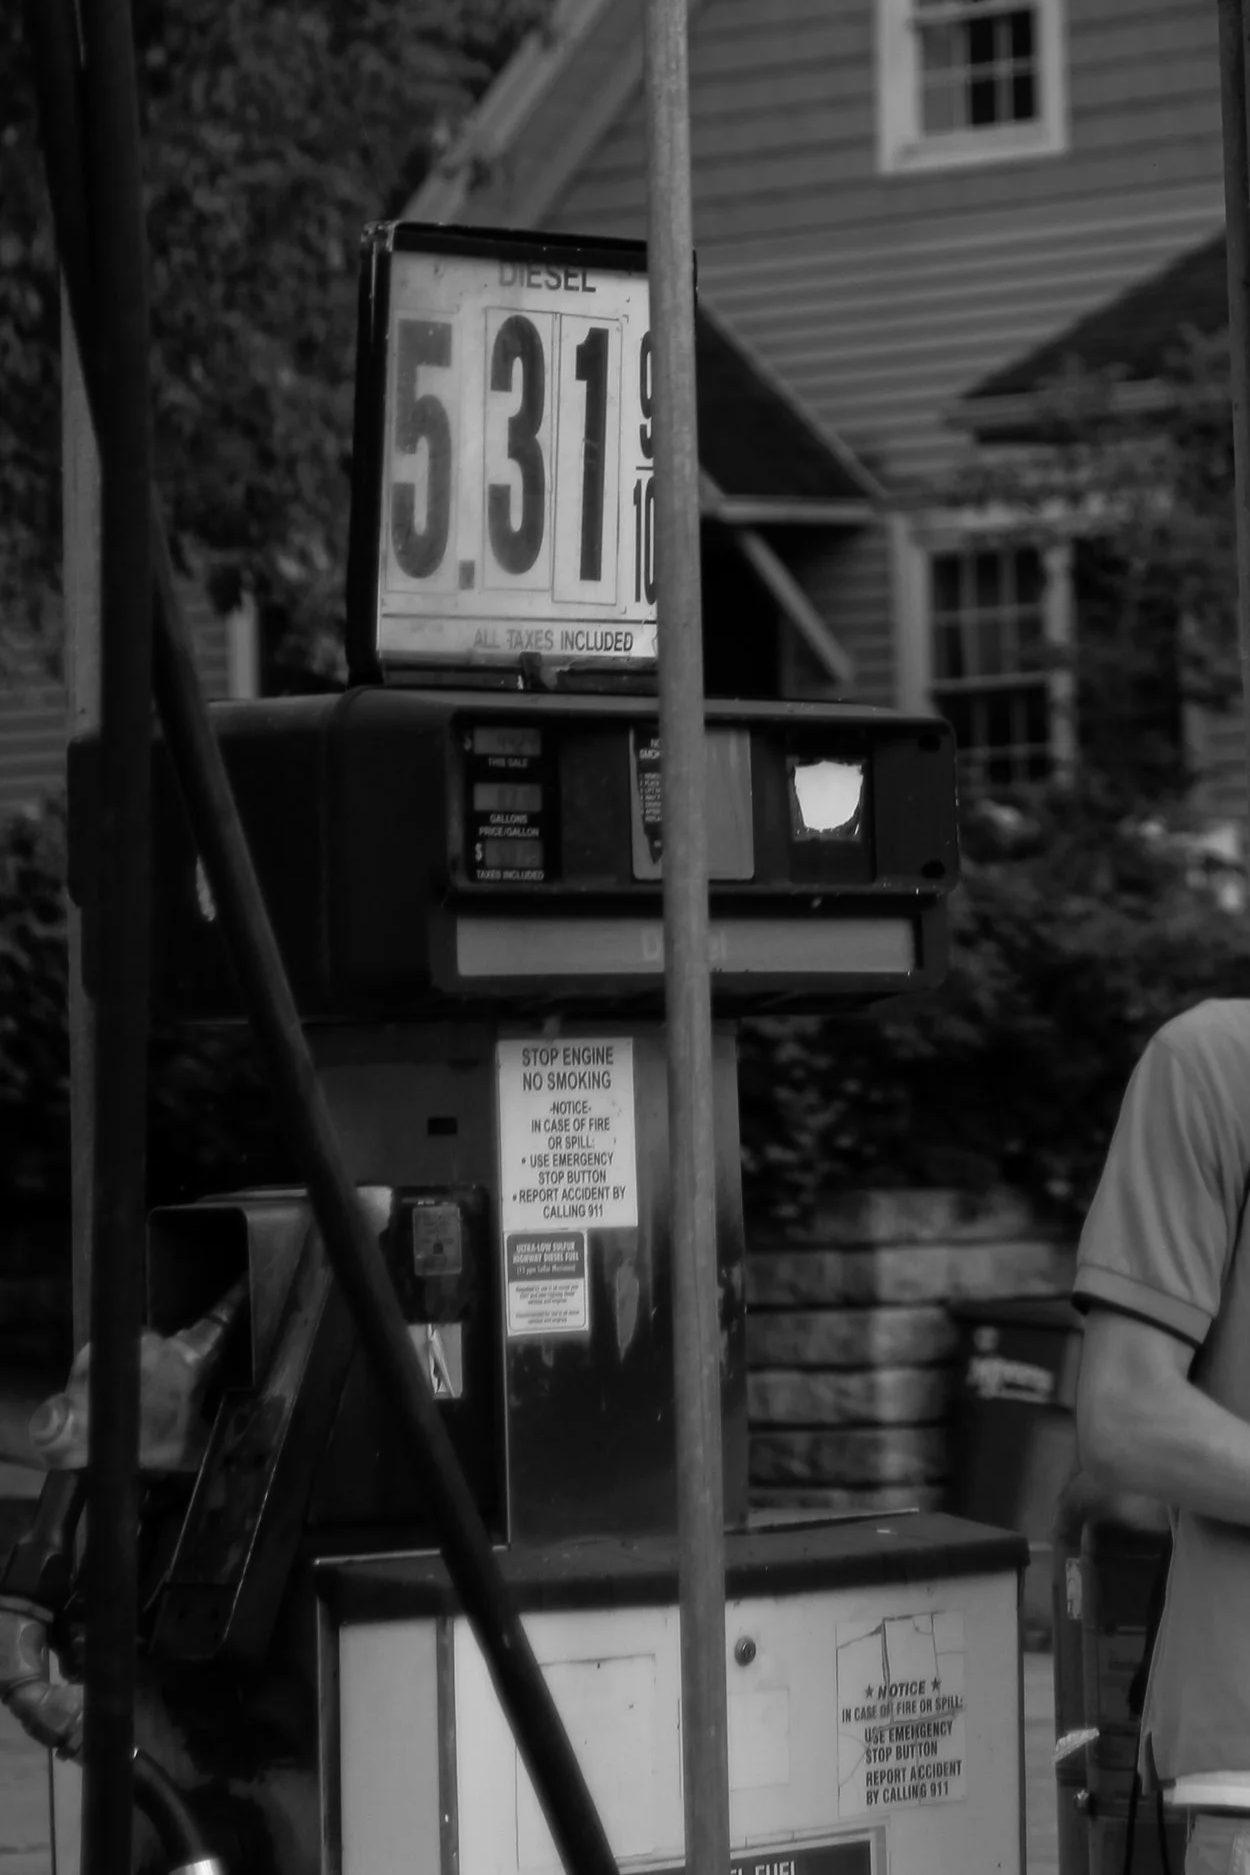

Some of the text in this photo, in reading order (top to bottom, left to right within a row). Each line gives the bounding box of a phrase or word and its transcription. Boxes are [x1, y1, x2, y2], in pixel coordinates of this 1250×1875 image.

[500, 263, 596, 293] DIESEL
[474, 628, 633, 652] ALL TAXES INCLUDED
[508, 758, 528, 768] SALE
[489, 814, 528, 824] GALLONS
[479, 827, 539, 838] PRICE/GALLON
[476, 869, 544, 880] TAXES INCLUDED
[522, 1046, 613, 1066] STOP ENGINE
[523, 1071, 611, 1091] NO SMOKING
[532, 1117, 610, 1133] IN CASE OF FIRE
[548, 1136, 562, 1149] OR
[530, 1152, 613, 1168] USE EMERGENCY
[539, 1170, 606, 1185] STOP BUTTON
[519, 1186, 626, 1203] REPORT ACCIDENT BY
[543, 1204, 603, 1219] CALLING 911
[878, 1680, 926, 1700] NOTICE
[842, 1708, 851, 1723] IN
[854, 1705, 876, 1721] CASE
[880, 1702, 891, 1718] OF
[897, 1700, 916, 1715] FIRE
[920, 1698, 932, 1713] OR
[865, 1720, 953, 1745] USE EMERGENCY
[866, 1740, 938, 1765] STOP BUTTON
[866, 1760, 962, 1787] REPORT ACCIDENT
[866, 1781, 949, 1805] BY CALLING 911
